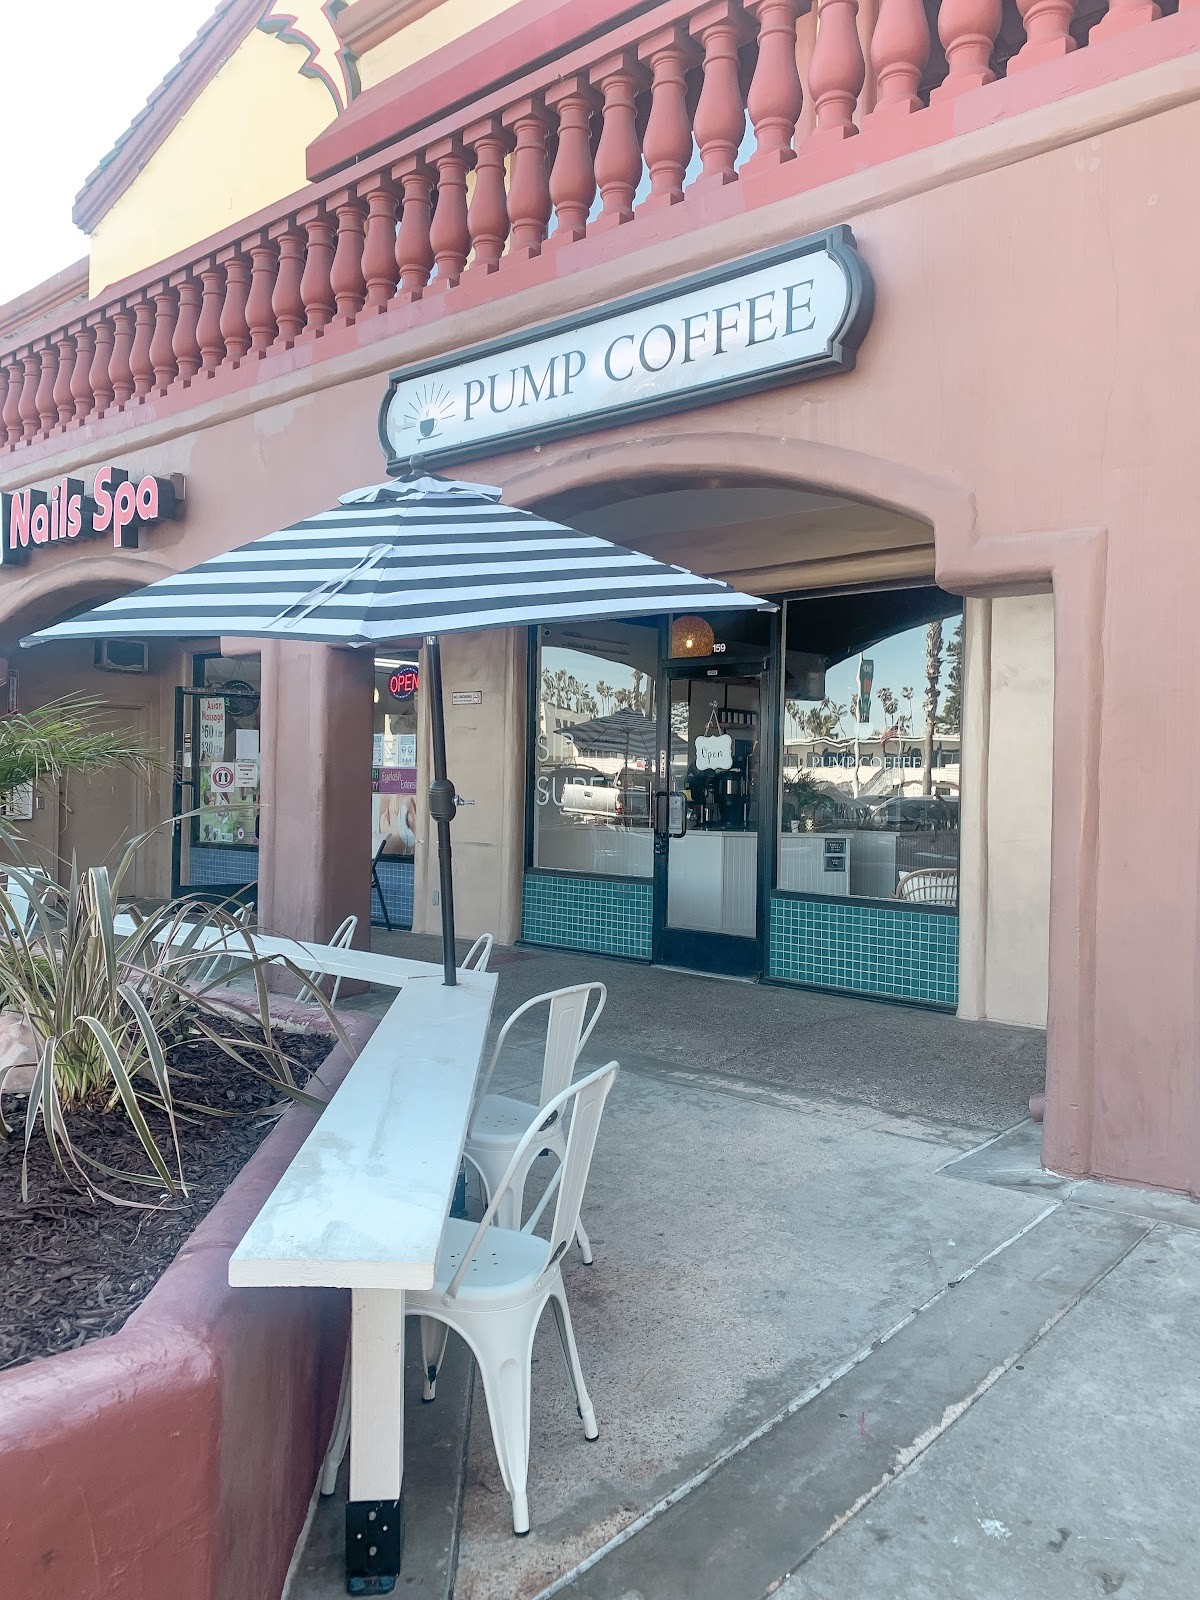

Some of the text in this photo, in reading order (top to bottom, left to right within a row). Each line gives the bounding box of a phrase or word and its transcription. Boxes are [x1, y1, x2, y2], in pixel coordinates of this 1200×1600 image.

[463, 279, 817, 422] PUMP COFFEE
[9, 477, 82, 549] Nails
[92, 466, 159, 548] Spa
[712, 643, 726, 653] 159
[390, 673, 419, 692] OPEN
[207, 700, 223, 710] Asian
[201, 711, 224, 723] Massage
[201, 724, 214, 738] $60
[201, 741, 213, 754] $30
[537, 732, 574, 762] SIP
[701, 746, 724, 764] Open
[812, 756, 922, 768] PUMP COFFEE
[381, 770, 402, 783] Eyelash
